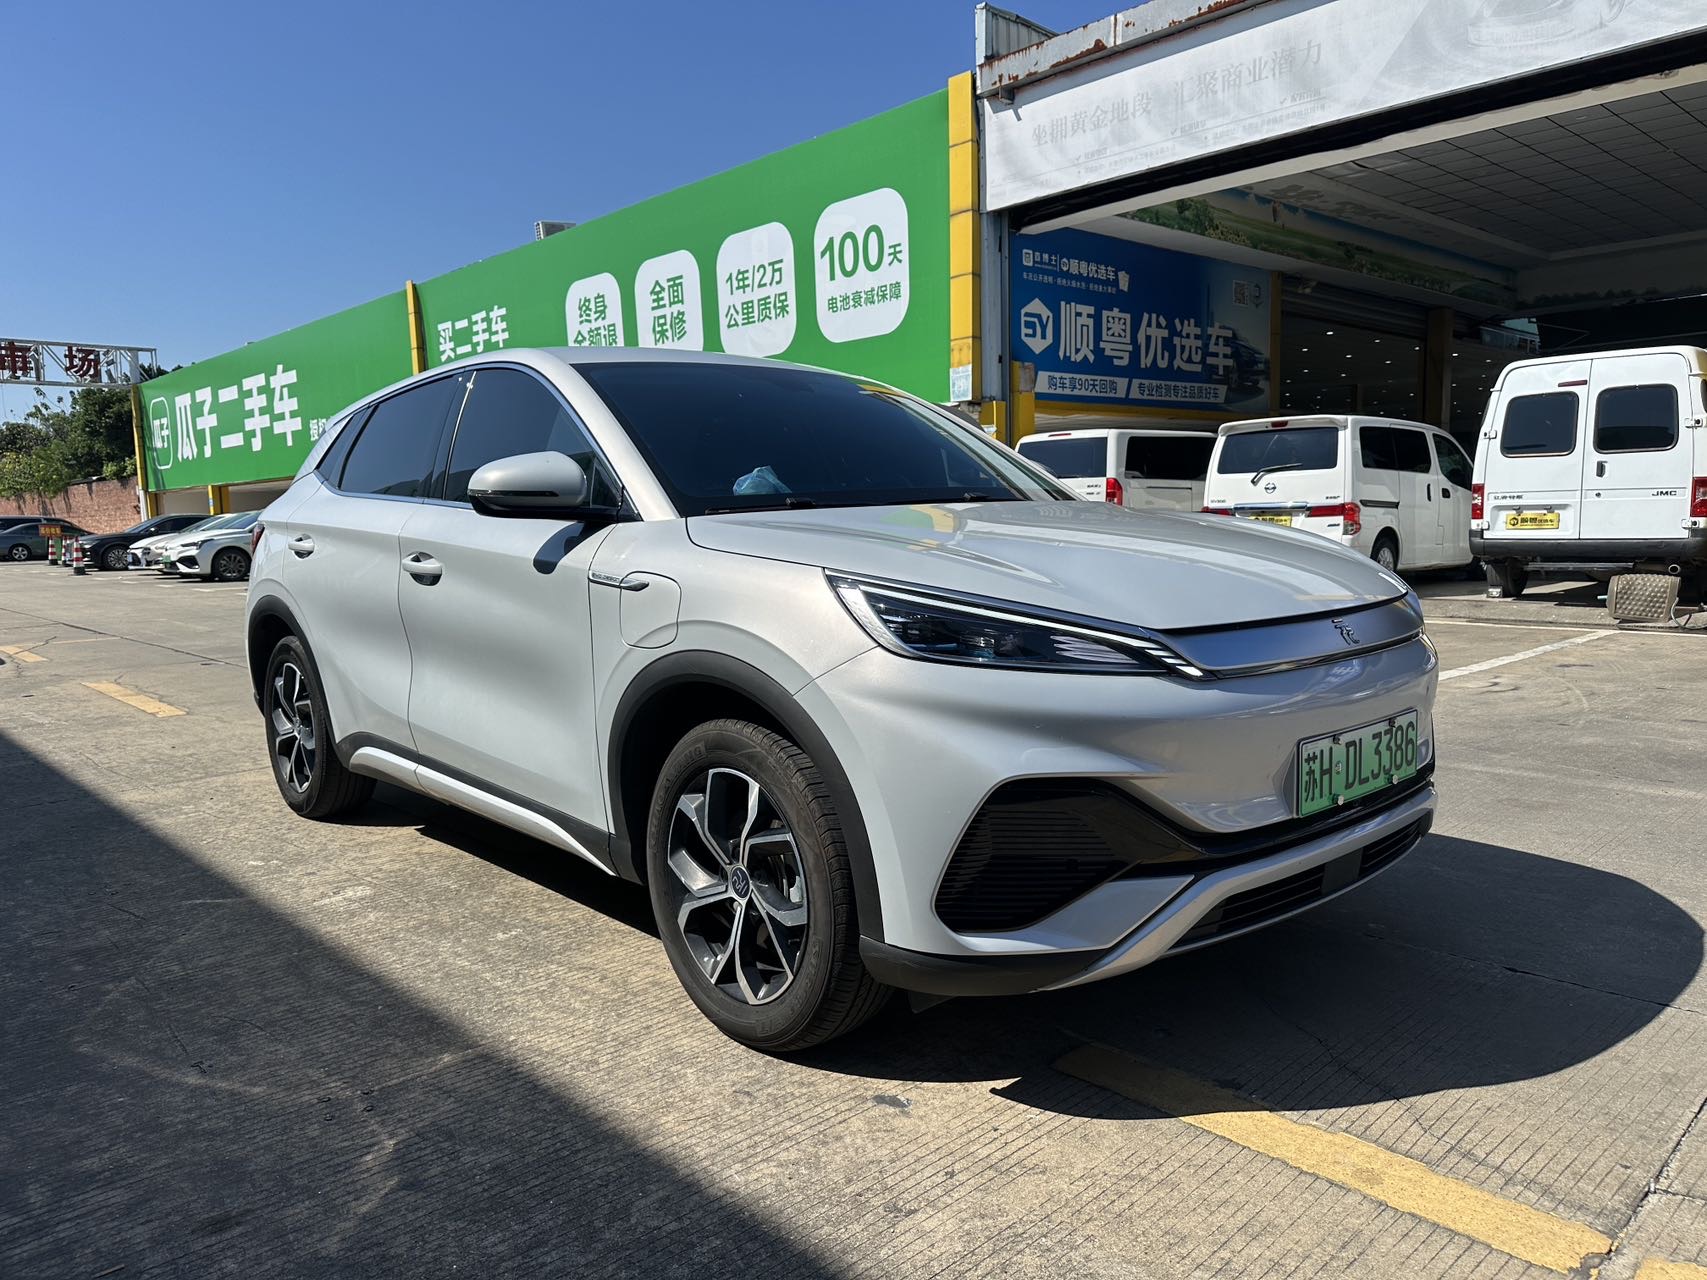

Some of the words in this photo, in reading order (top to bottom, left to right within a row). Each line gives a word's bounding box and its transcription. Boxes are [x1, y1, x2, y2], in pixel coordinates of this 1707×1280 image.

[1032, 91, 1152, 147] 坐拥黄金地段
[1174, 39, 1322, 111] 汇聚商业潜力
[725, 258, 784, 296] 1年/2万
[1069, 258, 1116, 282] 顺粤优选车
[578, 292, 608, 326] 终身
[649, 274, 685, 312] 全面
[725, 291, 790, 329] 公里质保
[827, 281, 903, 314] 电池衰减保障
[437, 305, 509, 362] 买二手车
[652, 310, 688, 346] 保修
[1058, 301, 1235, 377] 顺粤优选车
[1047, 374, 1118, 395] 购车享90天回购
[1137, 382, 1220, 401] 专业检测专注品质好车
[174, 364, 302, 463] 瓜子二手车
[153, 417, 170, 449] 瓜子
